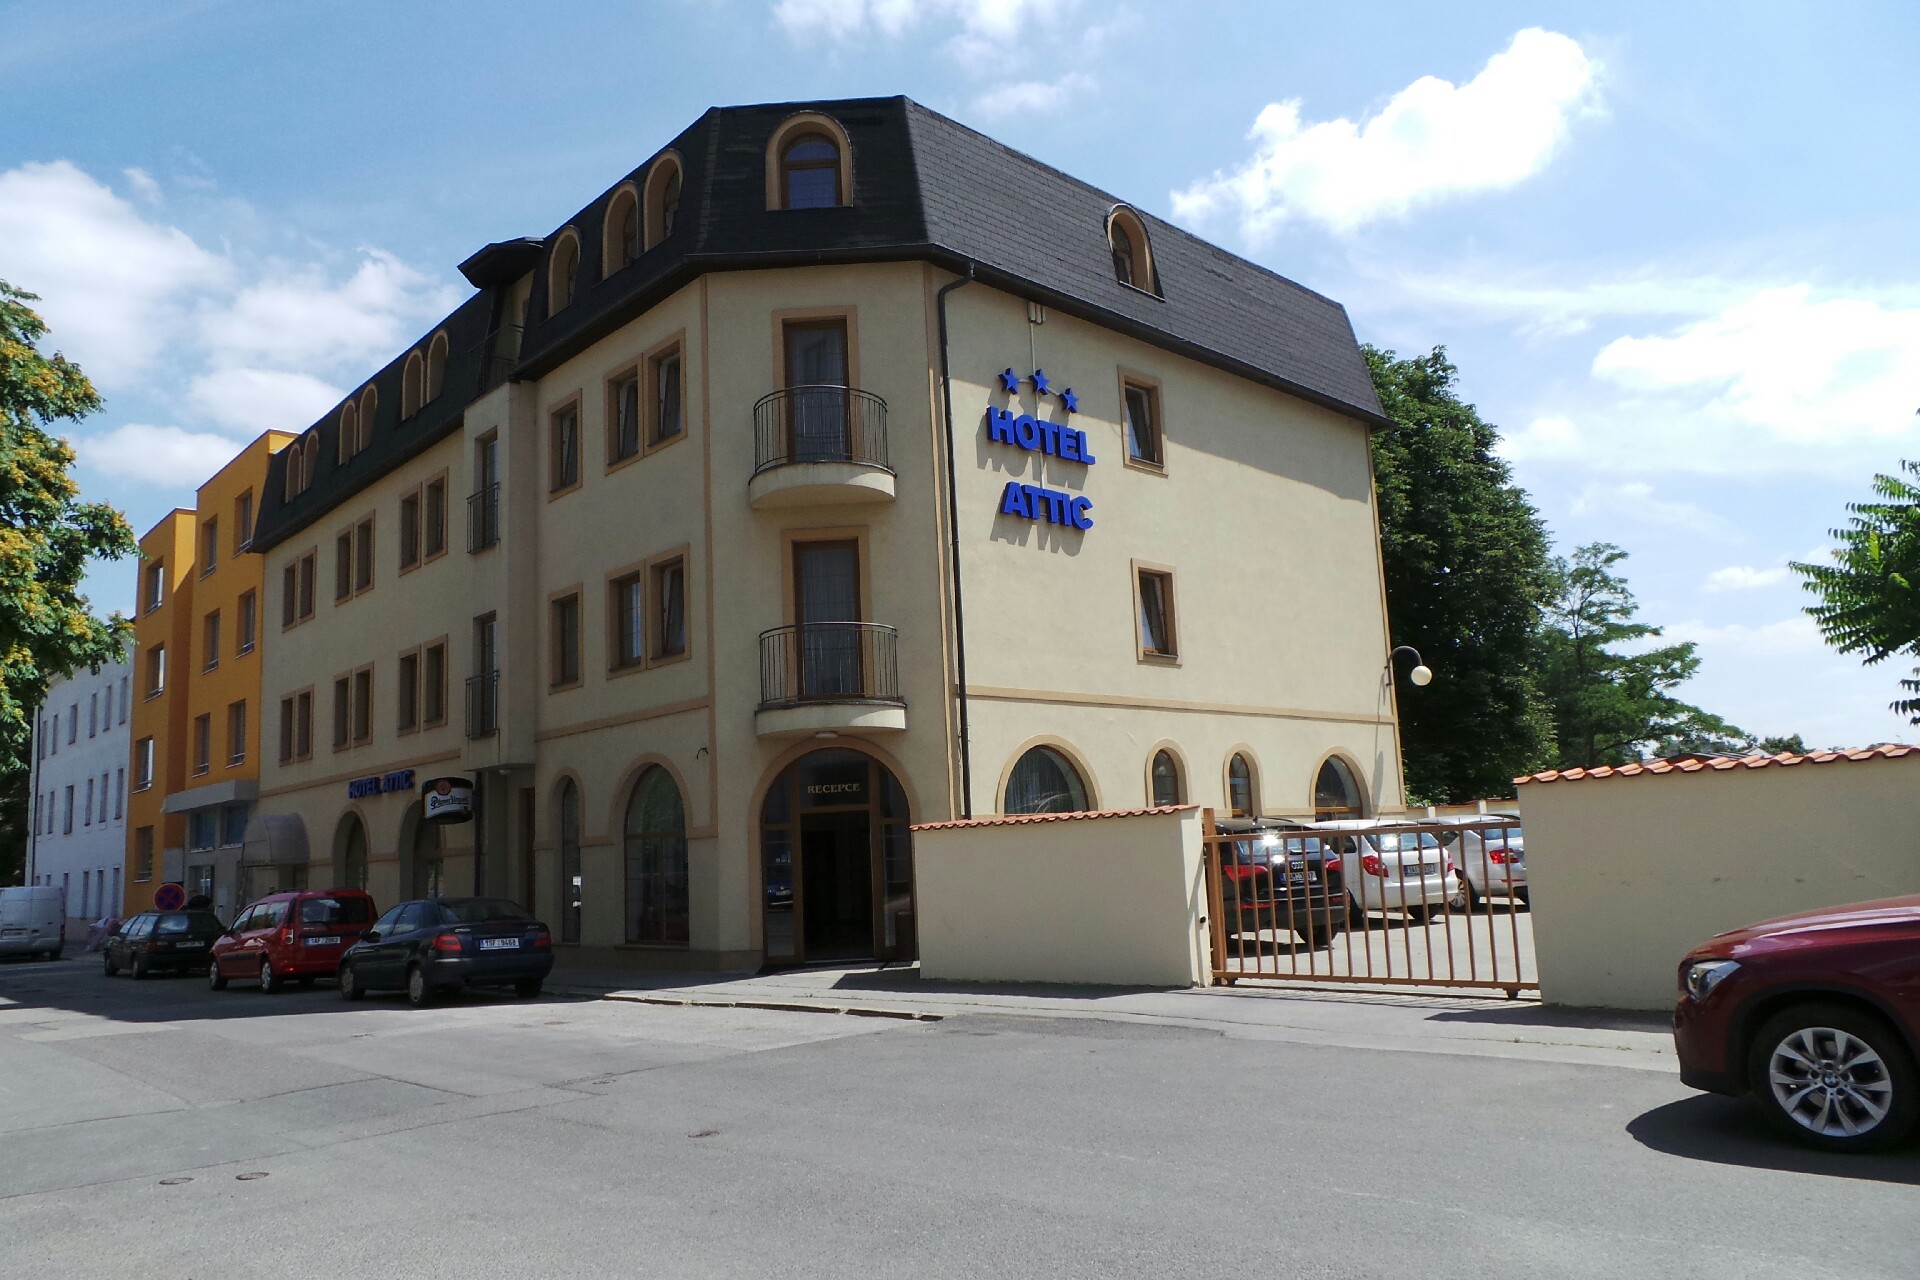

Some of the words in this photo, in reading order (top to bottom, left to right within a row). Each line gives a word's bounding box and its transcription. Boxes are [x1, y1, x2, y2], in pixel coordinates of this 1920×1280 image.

[987, 406, 1095, 465] HOTEL
[1001, 481, 1093, 530] ATTIC
[349, 777, 381, 798] HOTEL
[384, 769, 415, 793] ATTIC
[807, 783, 861, 794] RECEPCE
